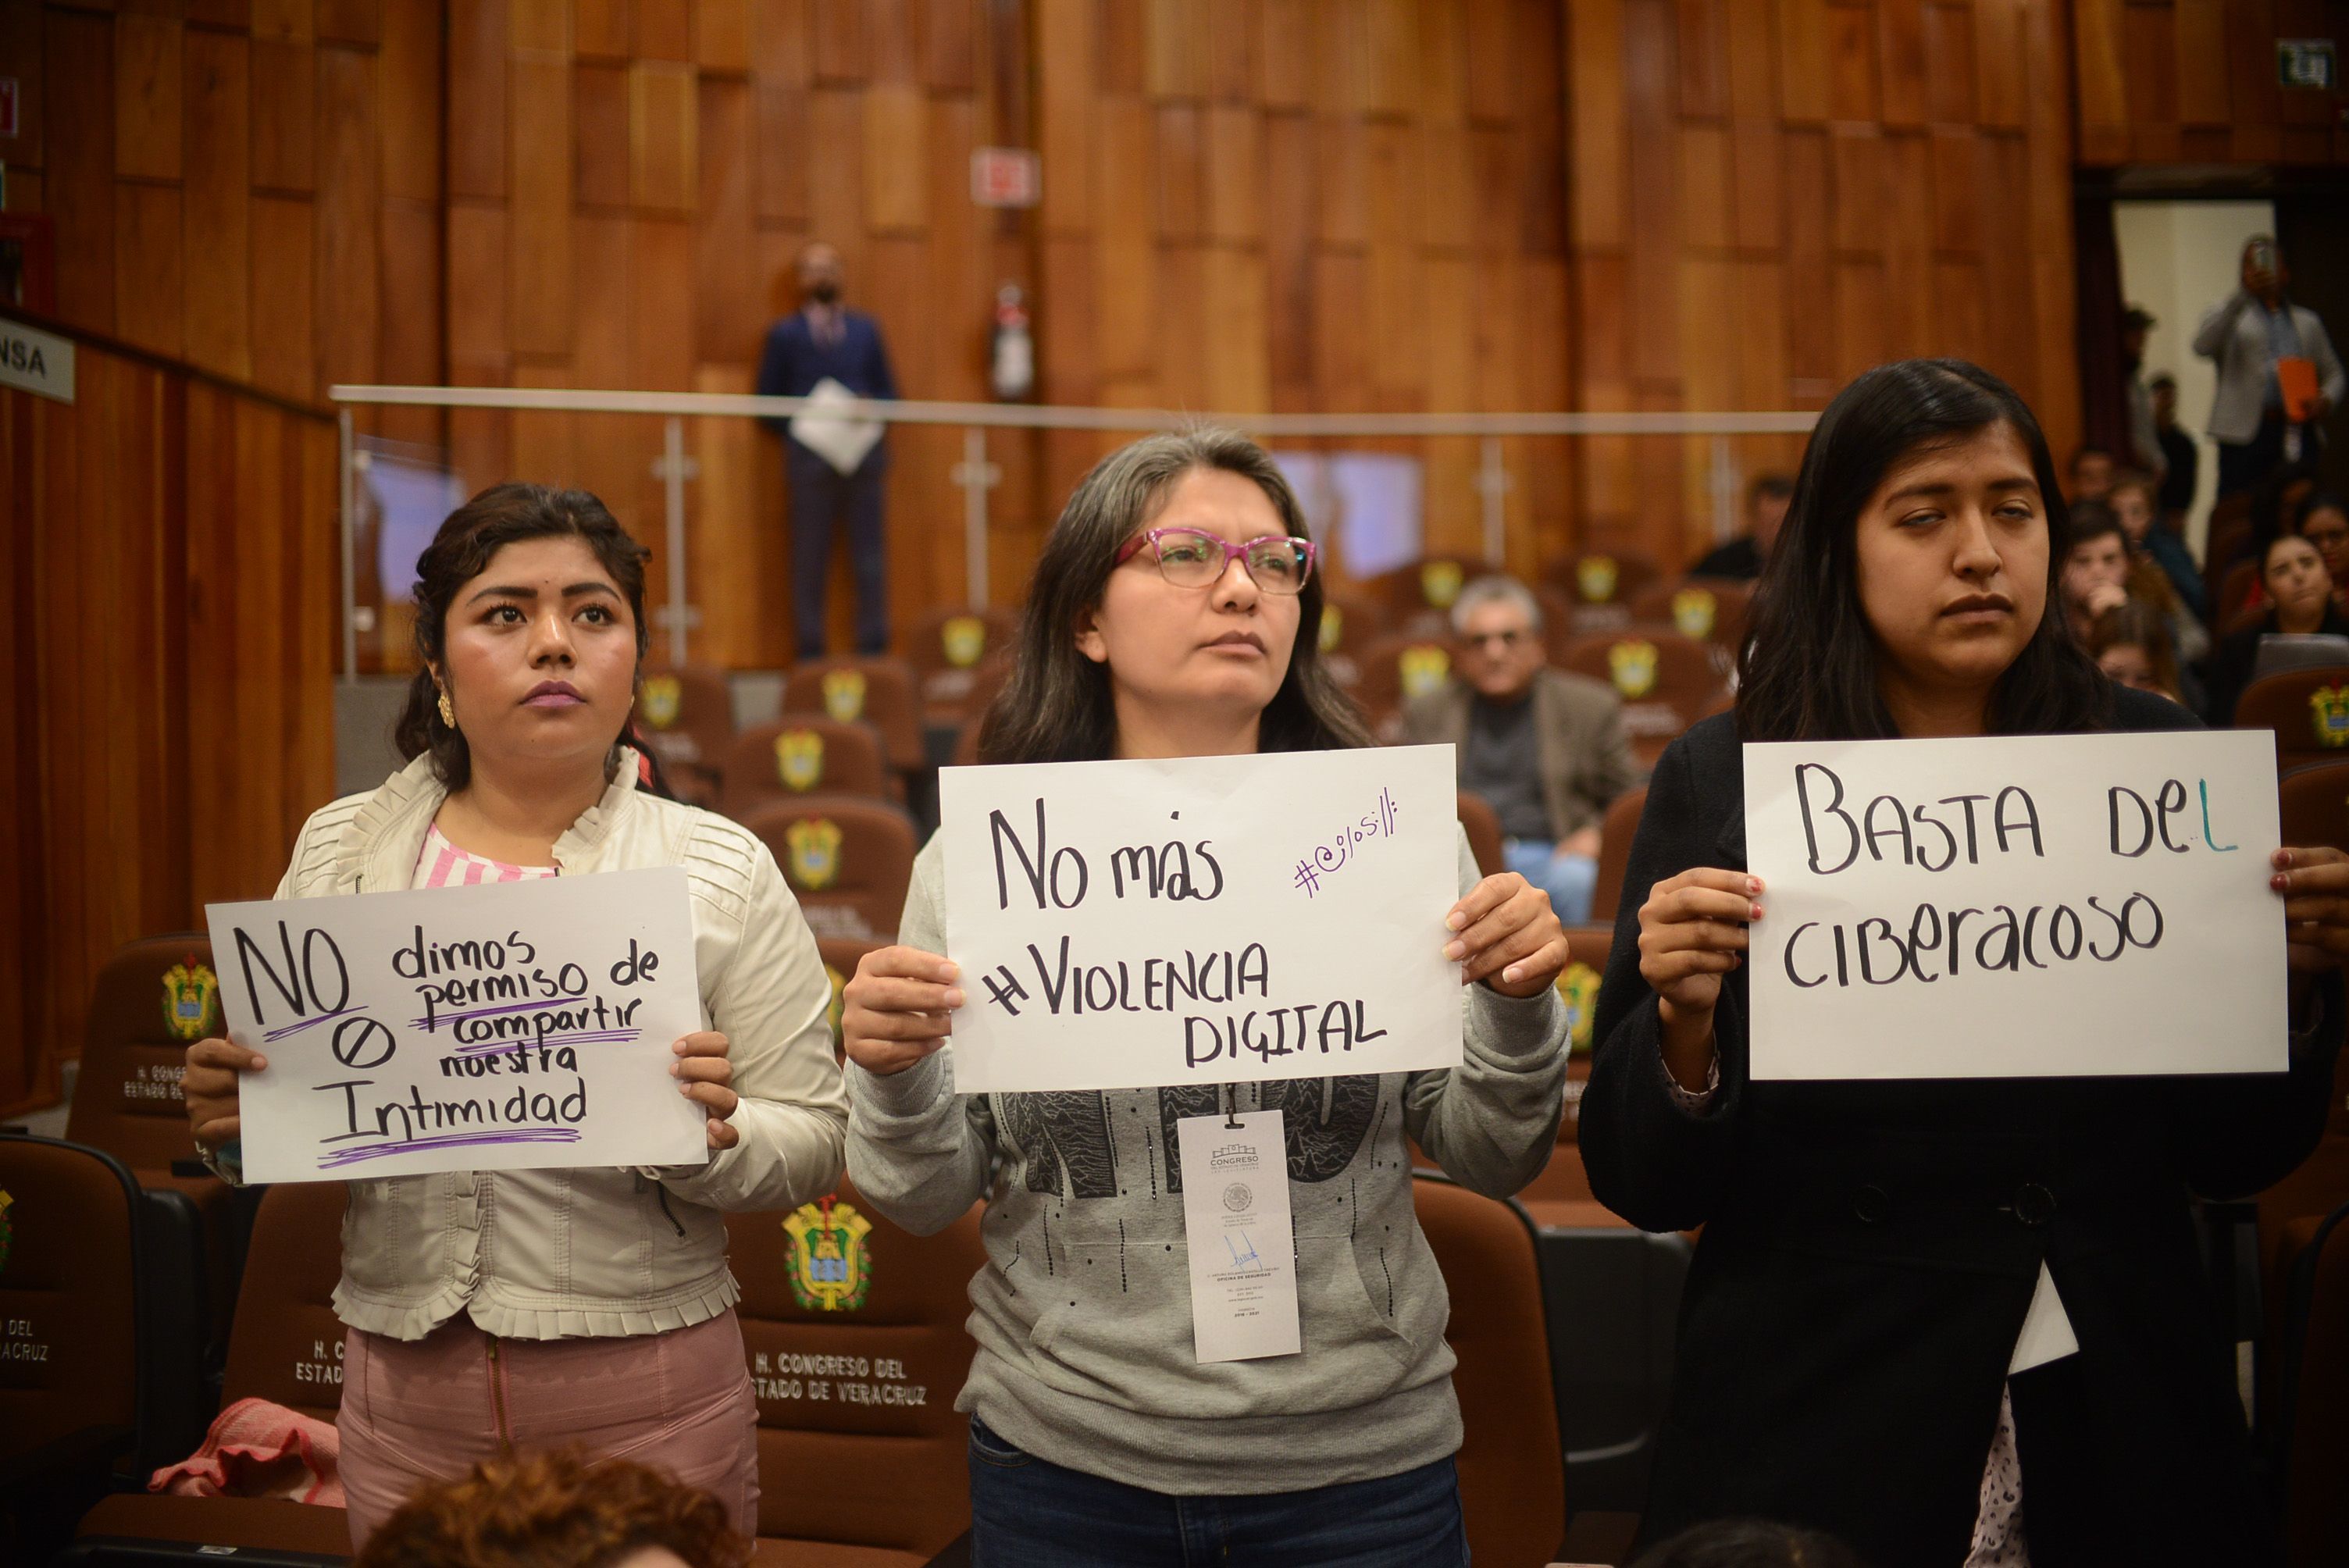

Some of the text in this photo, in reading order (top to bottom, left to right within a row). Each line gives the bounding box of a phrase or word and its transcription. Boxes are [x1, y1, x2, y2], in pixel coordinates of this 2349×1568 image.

[1795, 762, 2044, 875] BASTA
[391, 925, 536, 980] dimos
[609, 938, 660, 989] de
[233, 920, 351, 1026] NO
[1184, 999, 1388, 1068] DIGITAL
[1210, 1156, 1259, 1167] CONGRESO
[9, 1319, 33, 1337] DEL
[0, 1342, 48, 1362] ACRUZ
[778, 1352, 869, 1377] CONGRESO
[874, 1358, 907, 1380] DEL
[807, 1380, 830, 1400] DE
[837, 1381, 928, 1406] VERACRUZ
